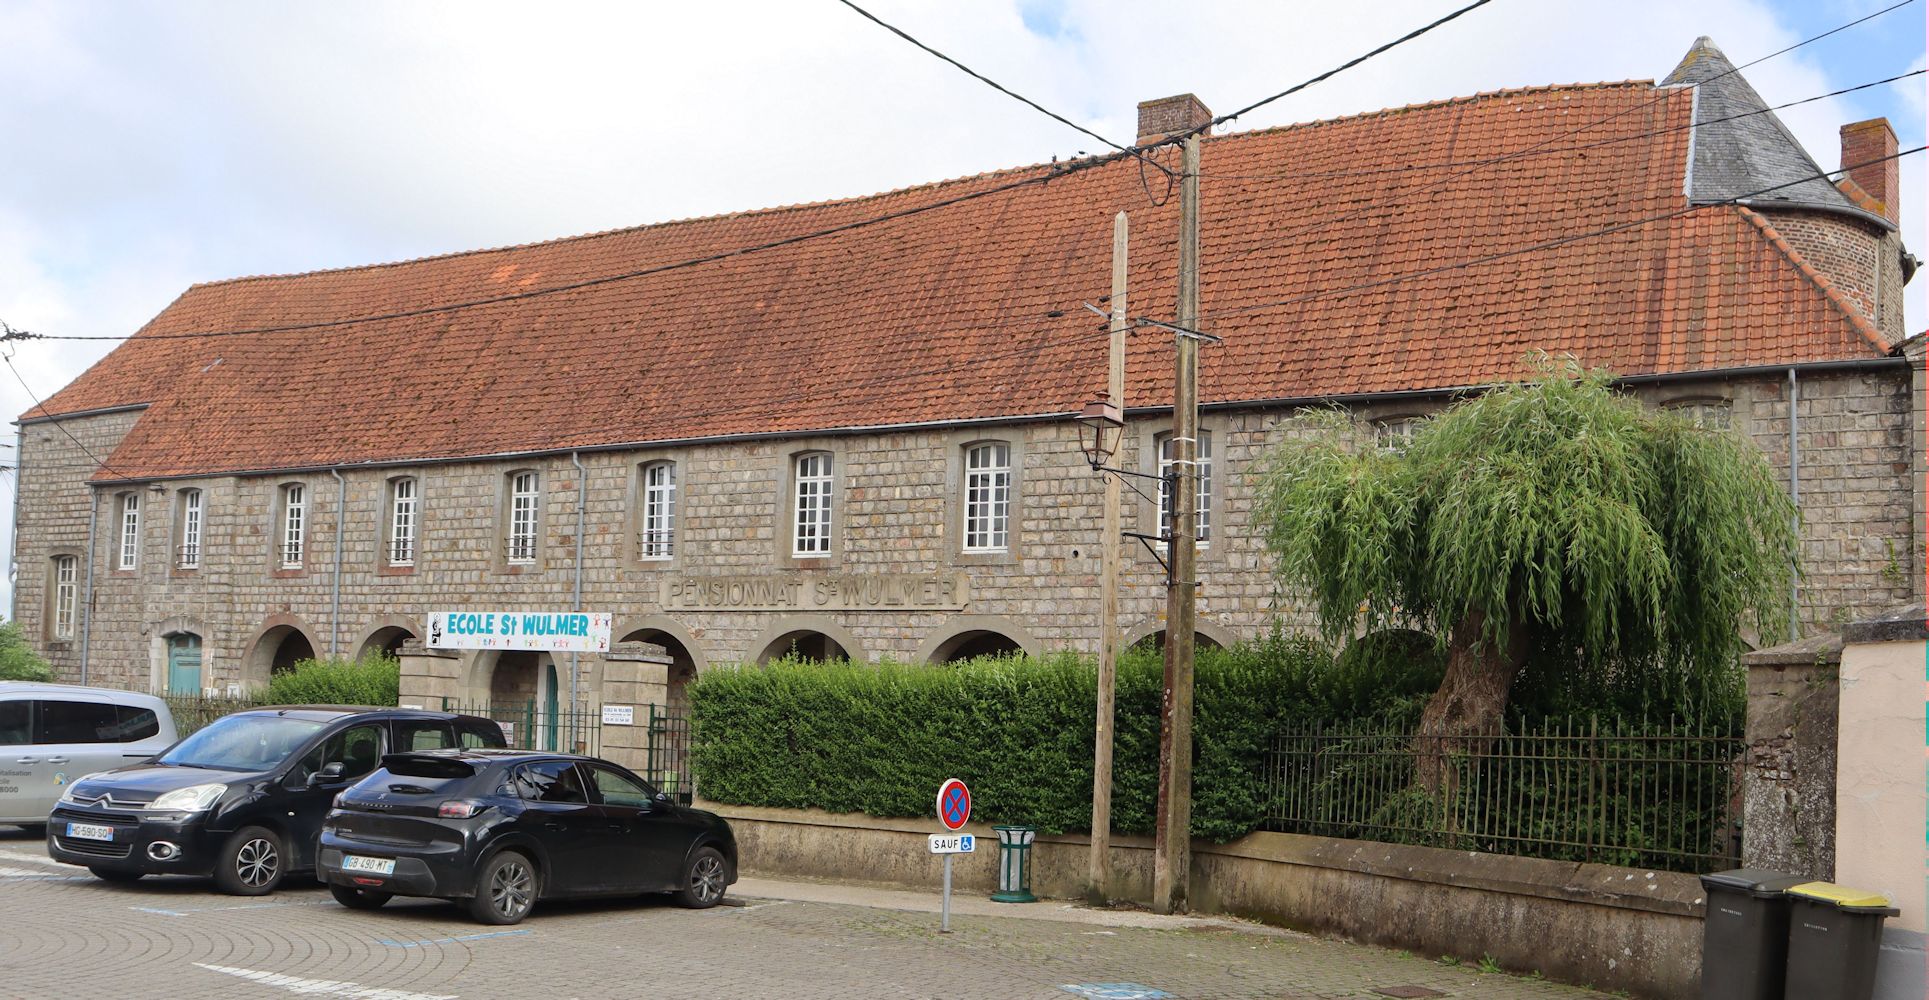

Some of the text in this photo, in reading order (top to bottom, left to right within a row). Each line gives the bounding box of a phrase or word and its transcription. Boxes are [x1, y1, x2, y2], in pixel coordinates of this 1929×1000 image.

[669, 579, 804, 606] PENSIONNAT
[840, 577, 958, 606] WULMER
[447, 613, 589, 637] ECOLE St WULMER
[934, 839, 958, 849] SAUF
